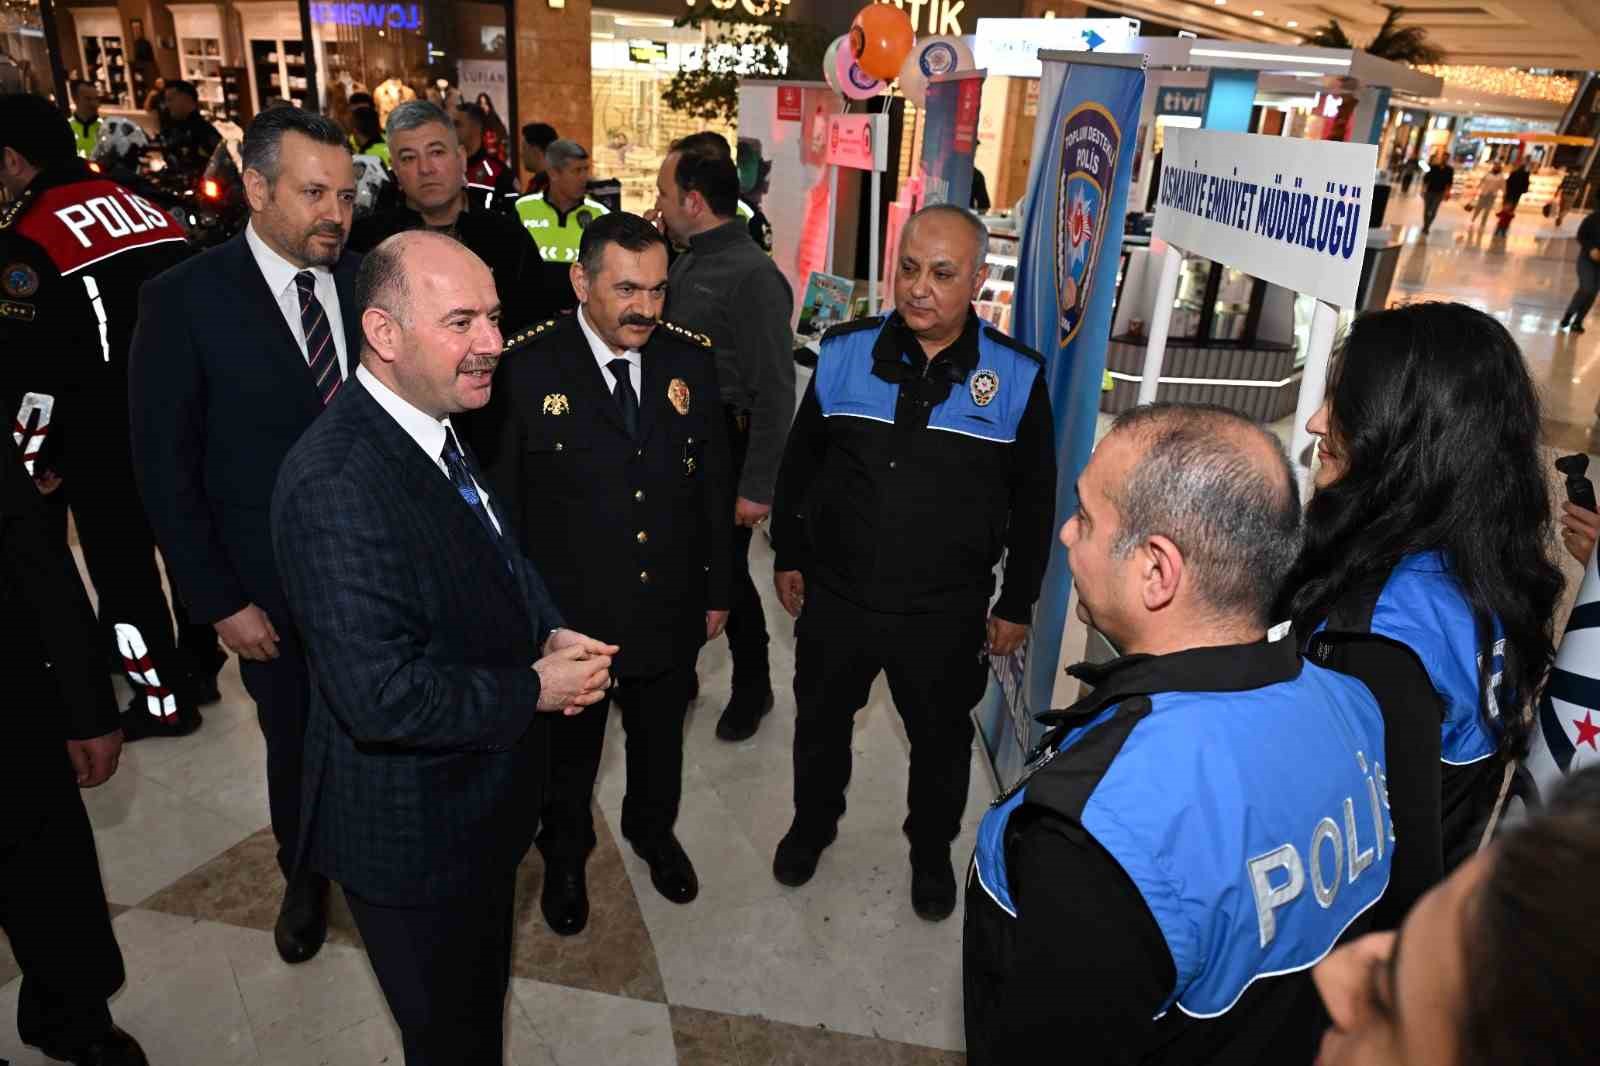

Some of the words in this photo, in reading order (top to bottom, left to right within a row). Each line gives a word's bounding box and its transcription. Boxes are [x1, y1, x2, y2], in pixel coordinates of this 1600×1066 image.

[1076, 147, 1100, 175] POLİS
[53, 186, 169, 249] POLİS
[1160, 160, 1208, 217] OSMANİYE
[1205, 167, 1258, 232] EMNİYET
[1255, 174, 1361, 260] MÜDÜRLÜĞÜ
